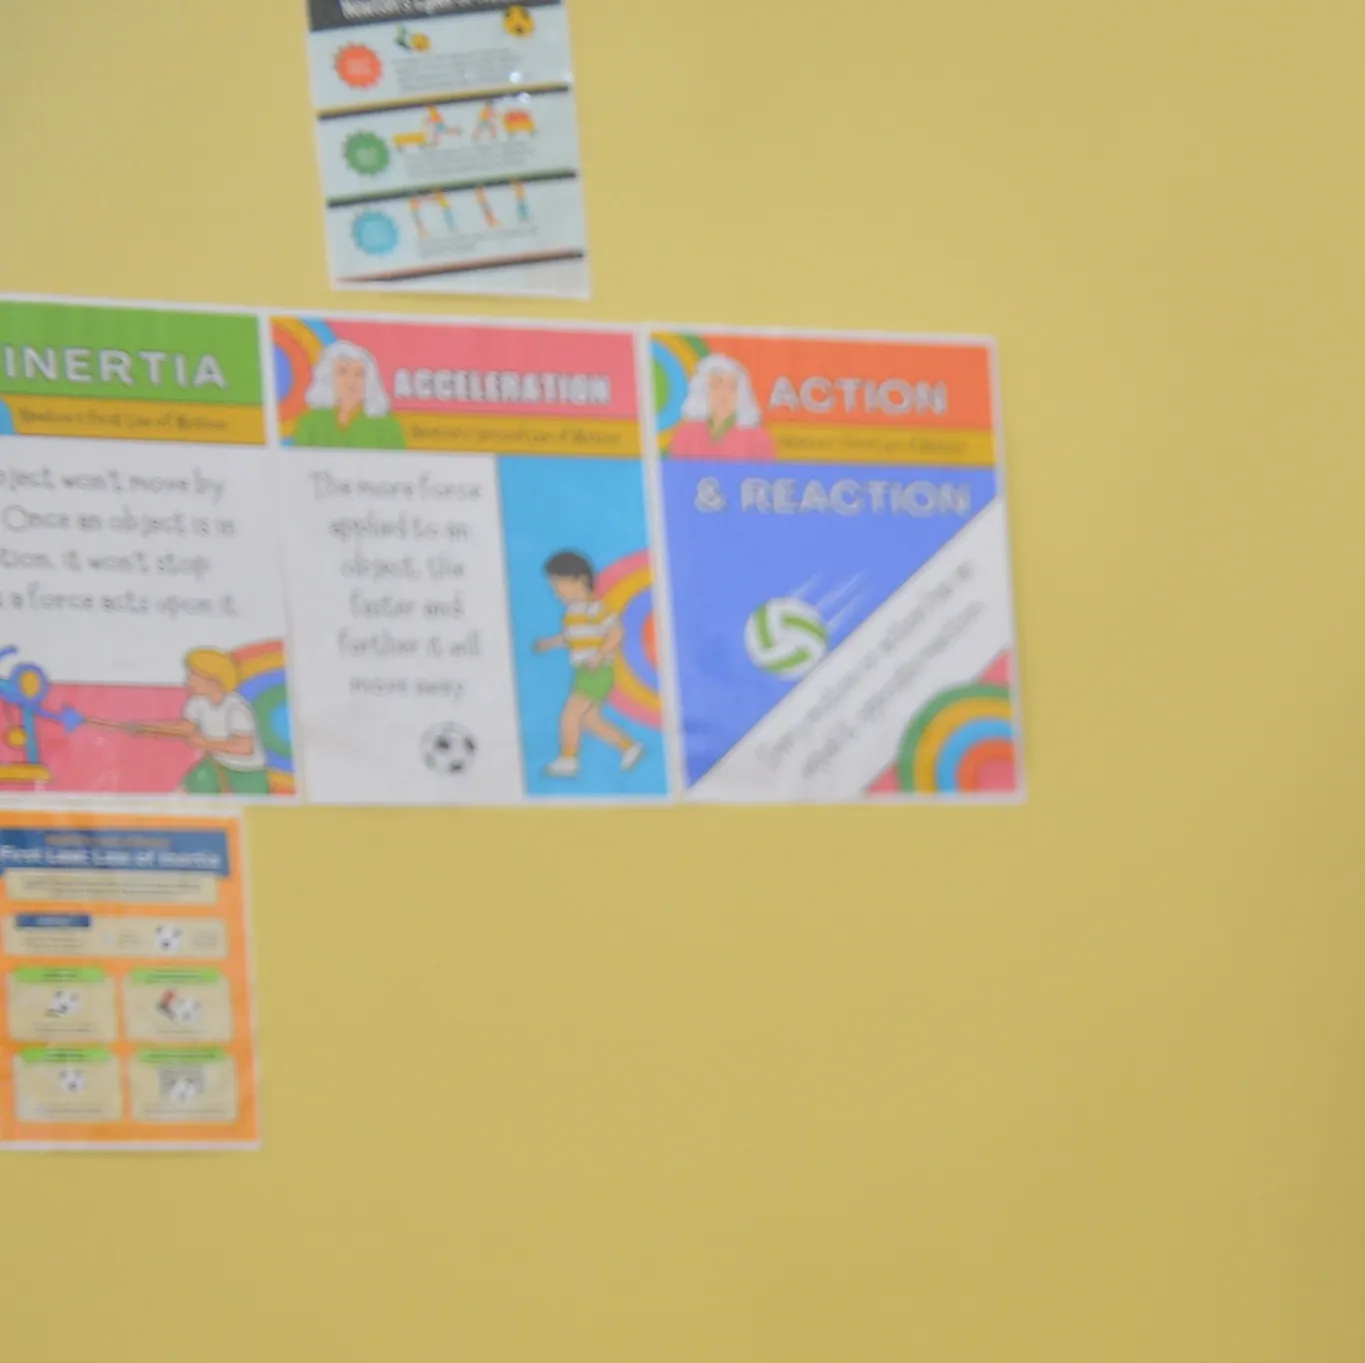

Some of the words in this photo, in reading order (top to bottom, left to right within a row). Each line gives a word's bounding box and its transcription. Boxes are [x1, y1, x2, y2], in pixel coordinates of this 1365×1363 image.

[3, 344, 228, 390] INERTIA
[394, 368, 611, 406] ACCELERATION
[769, 376, 948, 416] ACTION
[193, 466, 226, 506] by
[693, 476, 728, 513] &
[740, 477, 972, 518] REACTION
[2, 504, 70, 533] Once
[108, 503, 186, 539] object
